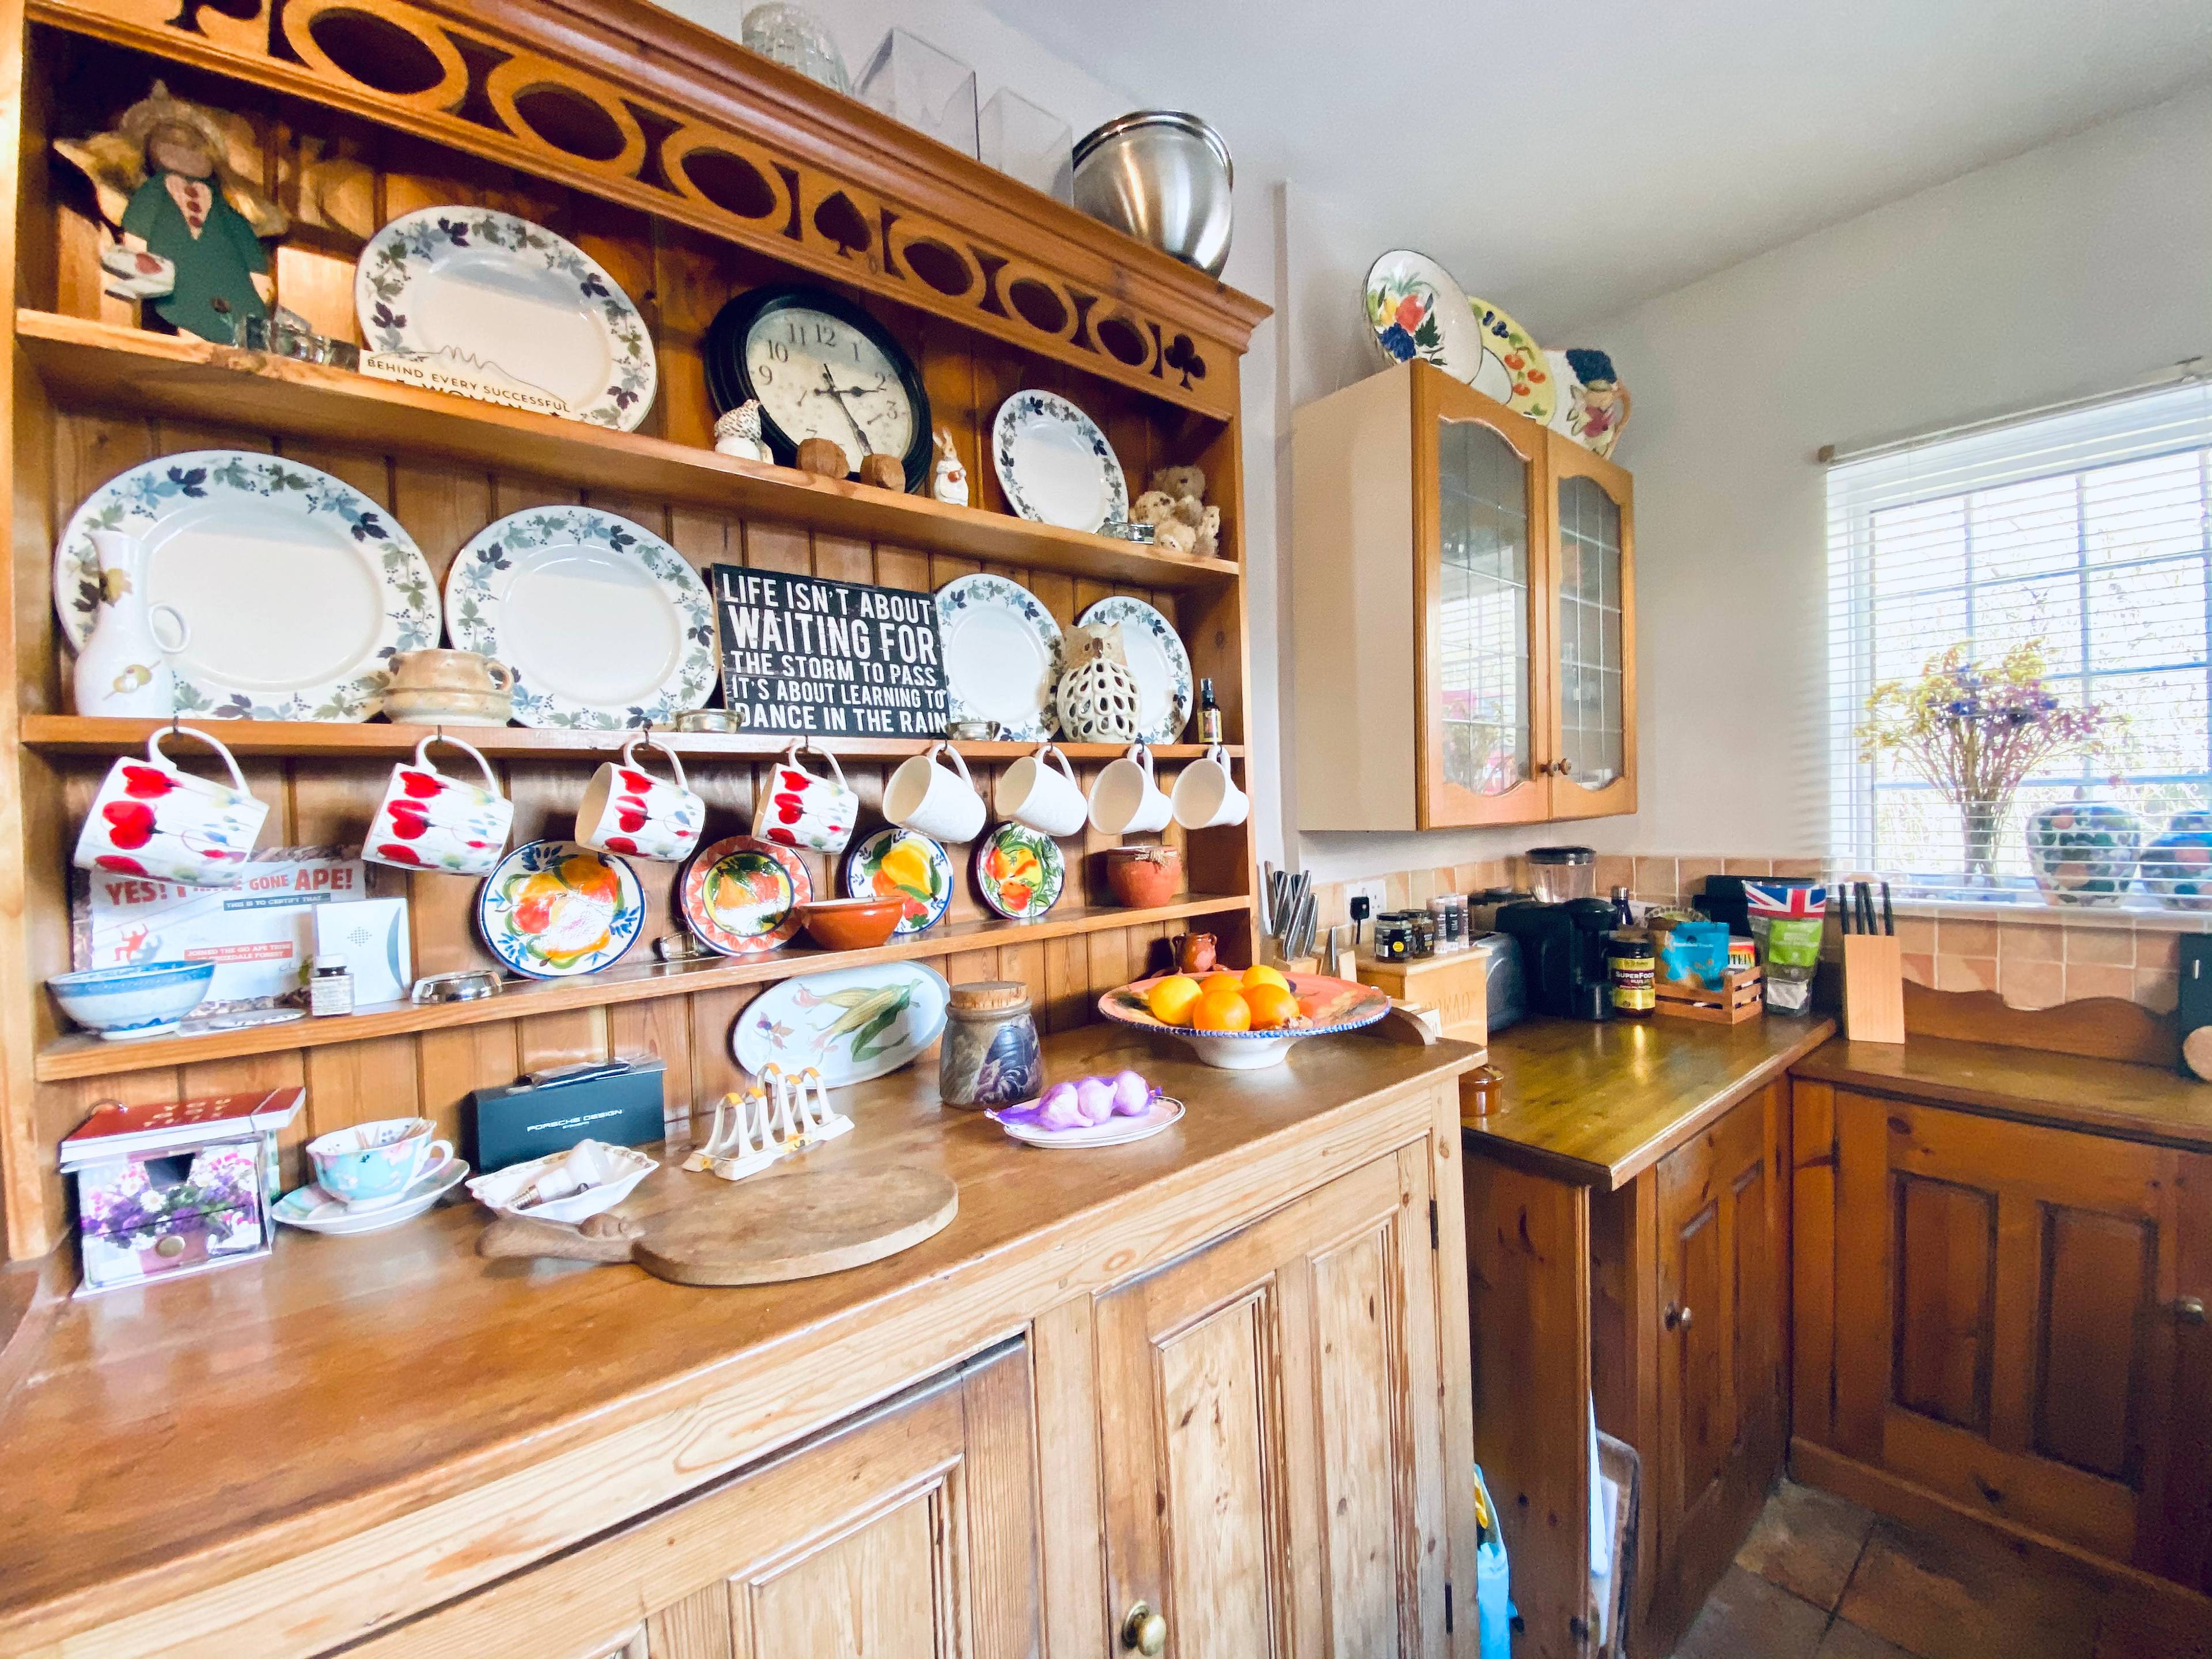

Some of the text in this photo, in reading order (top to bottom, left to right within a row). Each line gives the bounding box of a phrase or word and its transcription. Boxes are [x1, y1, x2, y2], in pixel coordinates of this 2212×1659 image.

[789, 323, 806, 346] 11
[816, 324, 835, 347] 12
[767, 339, 789, 363] 10
[851, 342, 861, 363] 1
[368, 358, 423, 378] BEHIND
[432, 373, 478, 391] EVERY
[483, 385, 571, 413] SUCCESSFUL
[758, 365, 773, 385] 9
[874, 371, 887, 391] 2
[887, 400, 897, 419] 3
[722, 573, 931, 625] LIFE ISN'T ABOUT
[727, 604, 938, 666] WAITING FOR
[730, 650, 937, 688] THE STORM TO PASS
[731, 674, 946, 710] IT'S ABOUT LEARNING TO
[735, 702, 948, 734] DANCE IN THE RAIN
[105, 880, 168, 906] YES!
[249, 874, 289, 891] GONE
[294, 868, 353, 891] APE!
[527, 1117, 581, 1132] PORSCHE
[583, 1109, 623, 1121] DESIGN
